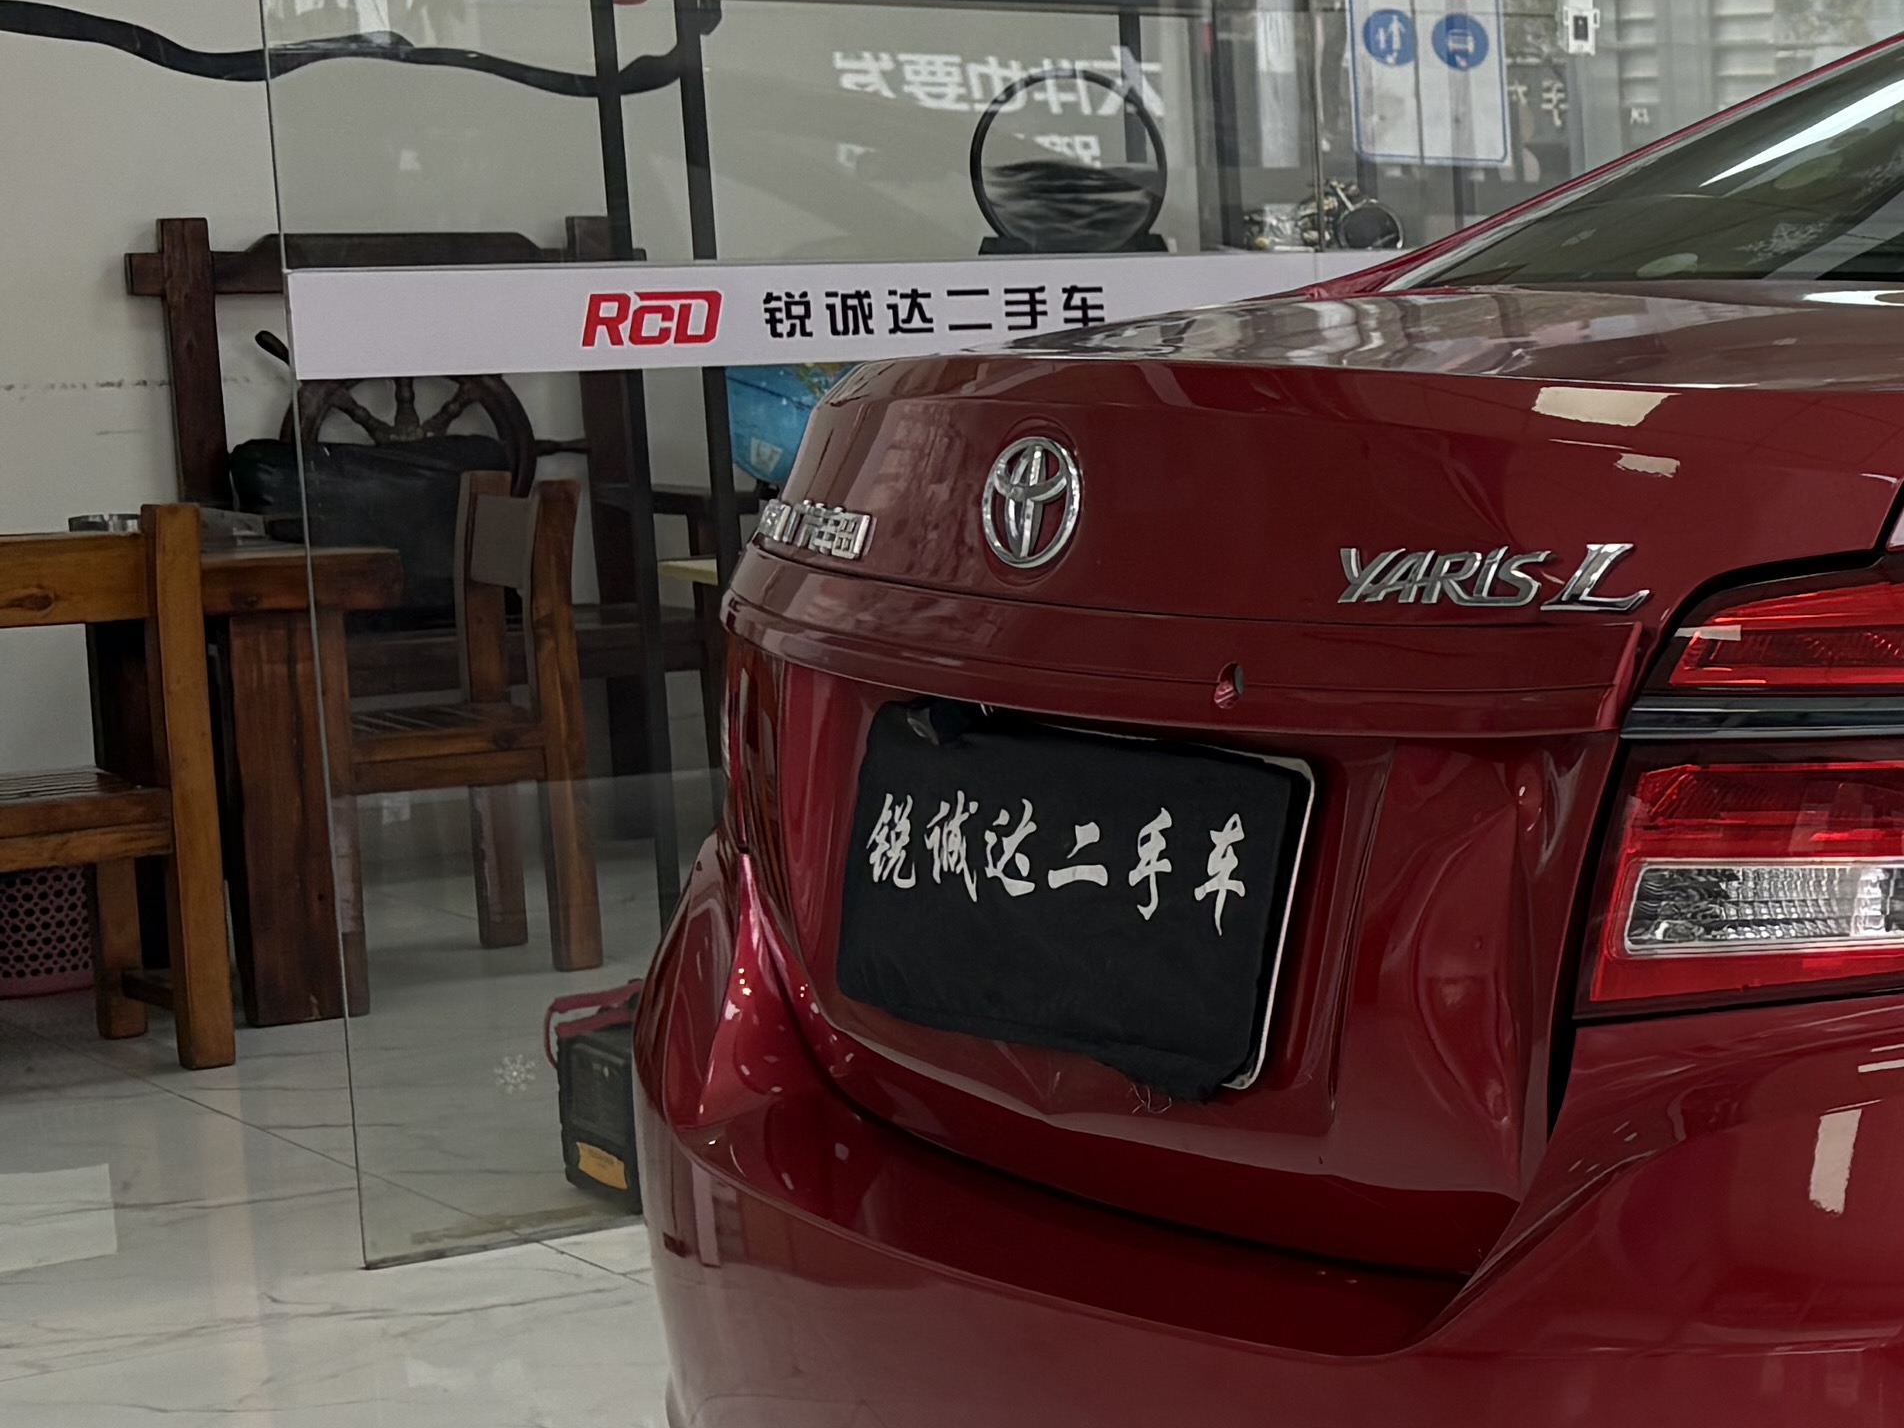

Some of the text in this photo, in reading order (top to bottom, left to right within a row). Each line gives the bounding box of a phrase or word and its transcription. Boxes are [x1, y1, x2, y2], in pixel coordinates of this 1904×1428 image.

[582, 284, 1106, 347] RCD 锐诚达二手车
[867, 790, 1246, 937] 锐诚达二手车
